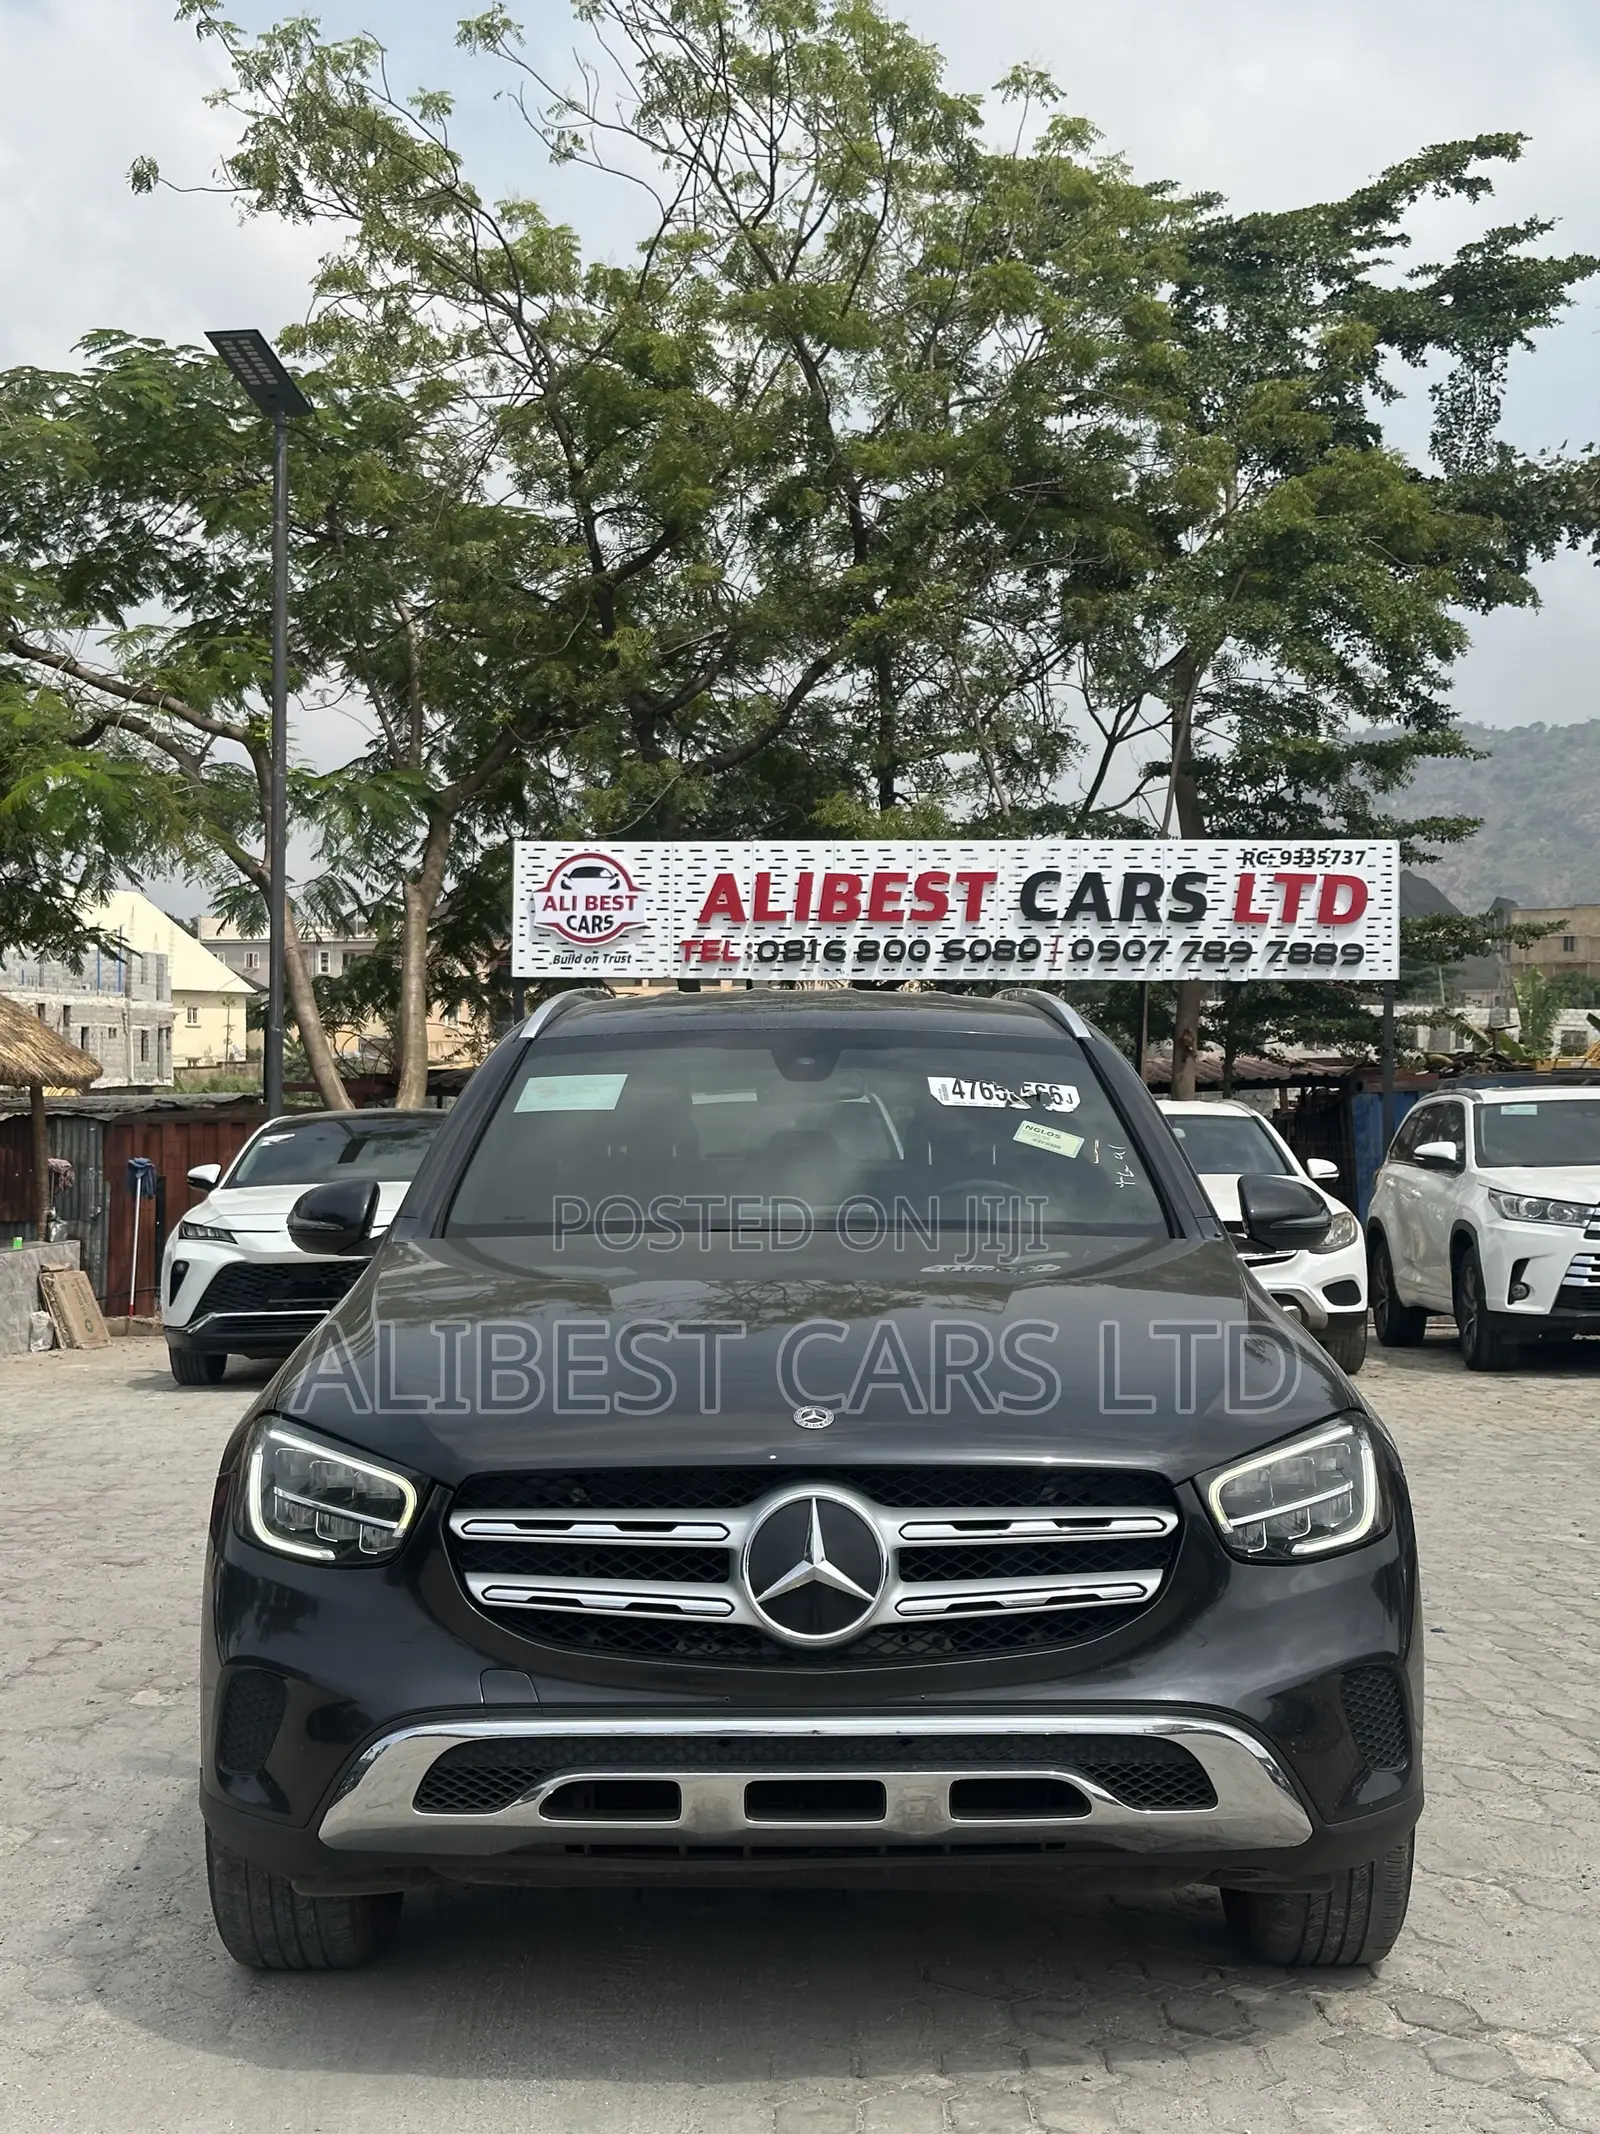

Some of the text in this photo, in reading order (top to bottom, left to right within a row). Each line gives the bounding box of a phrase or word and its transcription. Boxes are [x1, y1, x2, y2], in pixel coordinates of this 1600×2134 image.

[1280, 850, 1366, 866] 9335737
[542, 895, 638, 911] ALI BEST
[697, 871, 1369, 925] ALIBEST CARS LTD
[566, 914, 614, 934] CARS
[584, 956, 599, 964] on
[603, 953, 632, 964] Trust
[856, 939, 931, 962] 800
[943, 938, 1042, 962] 6080
[1071, 938, 1170, 962] 0907
[1181, 940, 1253, 963] 789
[1265, 940, 1365, 965] 7889
